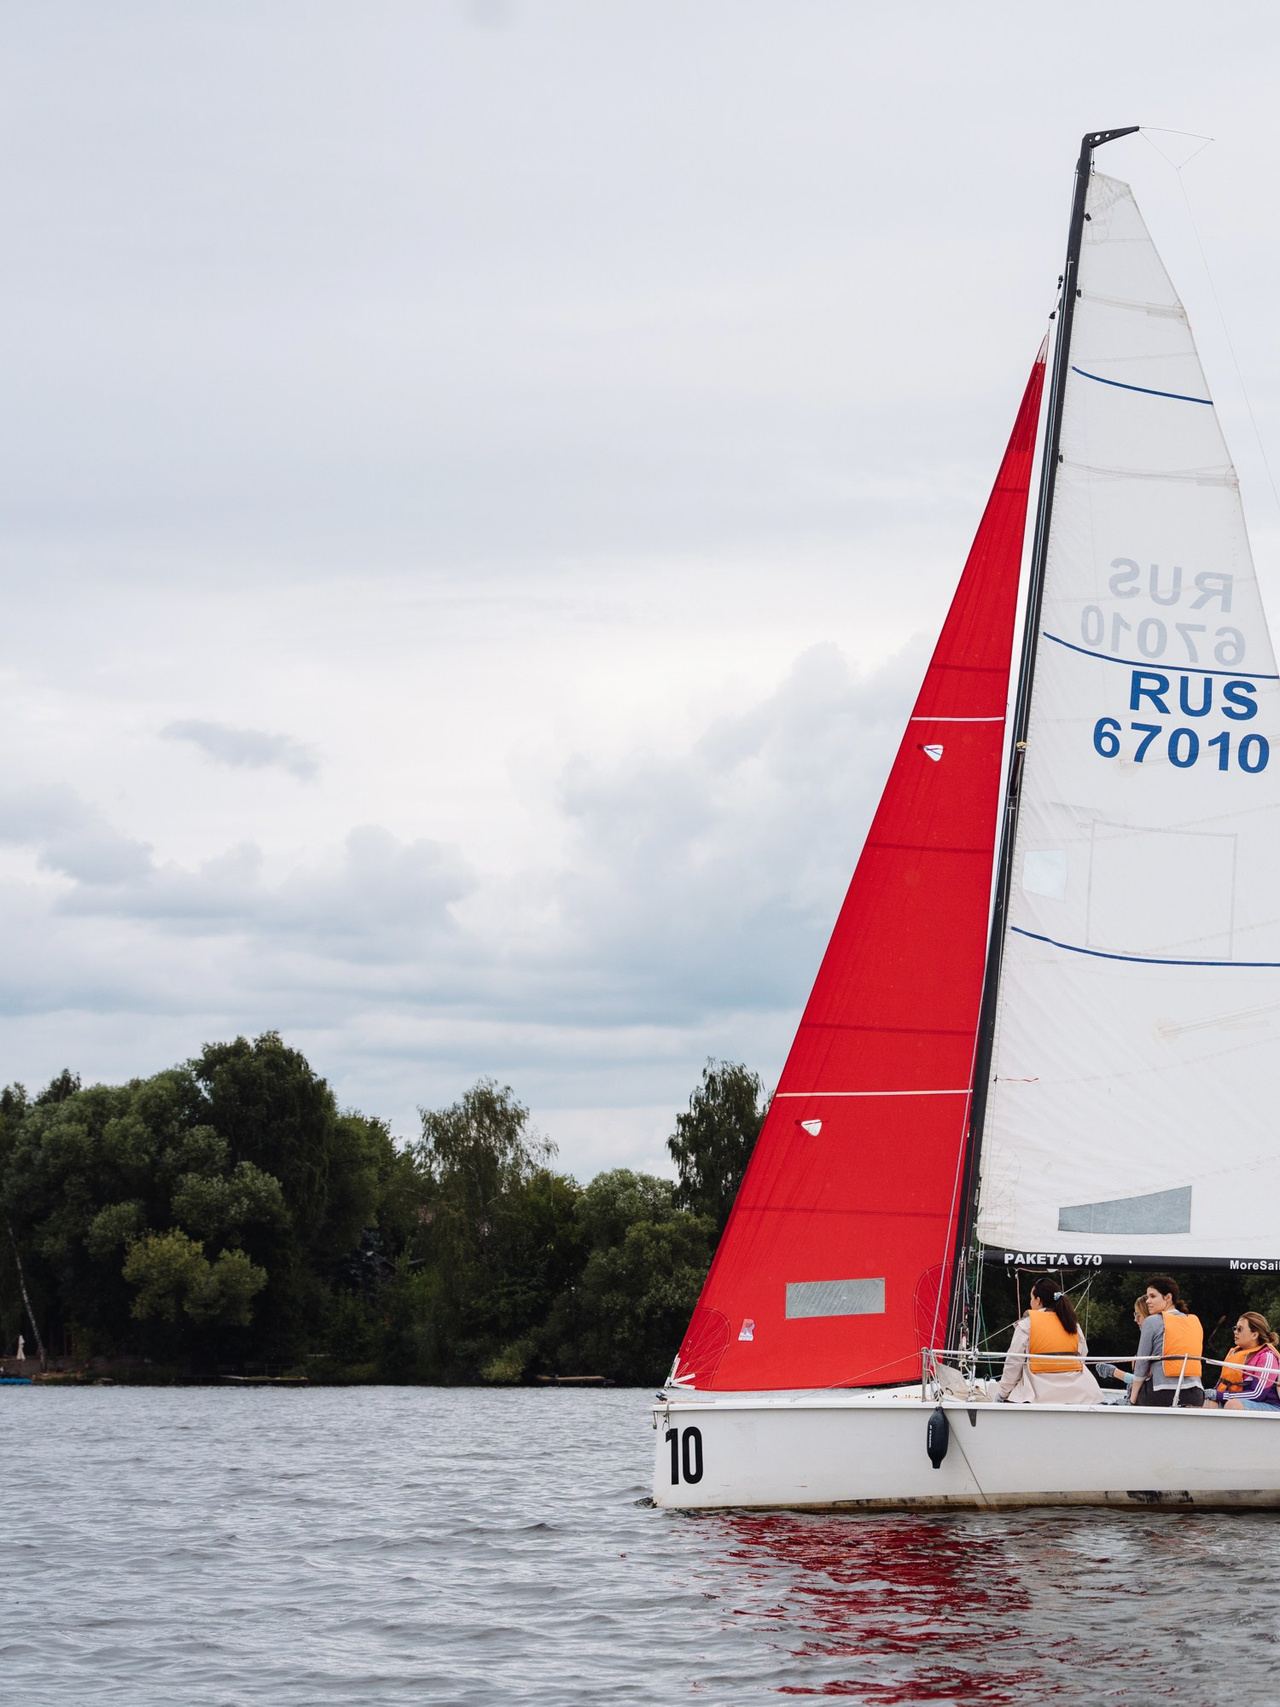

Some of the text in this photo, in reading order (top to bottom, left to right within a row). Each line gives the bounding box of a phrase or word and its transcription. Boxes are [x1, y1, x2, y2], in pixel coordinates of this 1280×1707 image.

[1129, 670, 1258, 720] RUS
[1093, 717, 1270, 773] 67010
[1073, 1254, 1102, 1266] 670
[665, 1426, 704, 1485] 10
